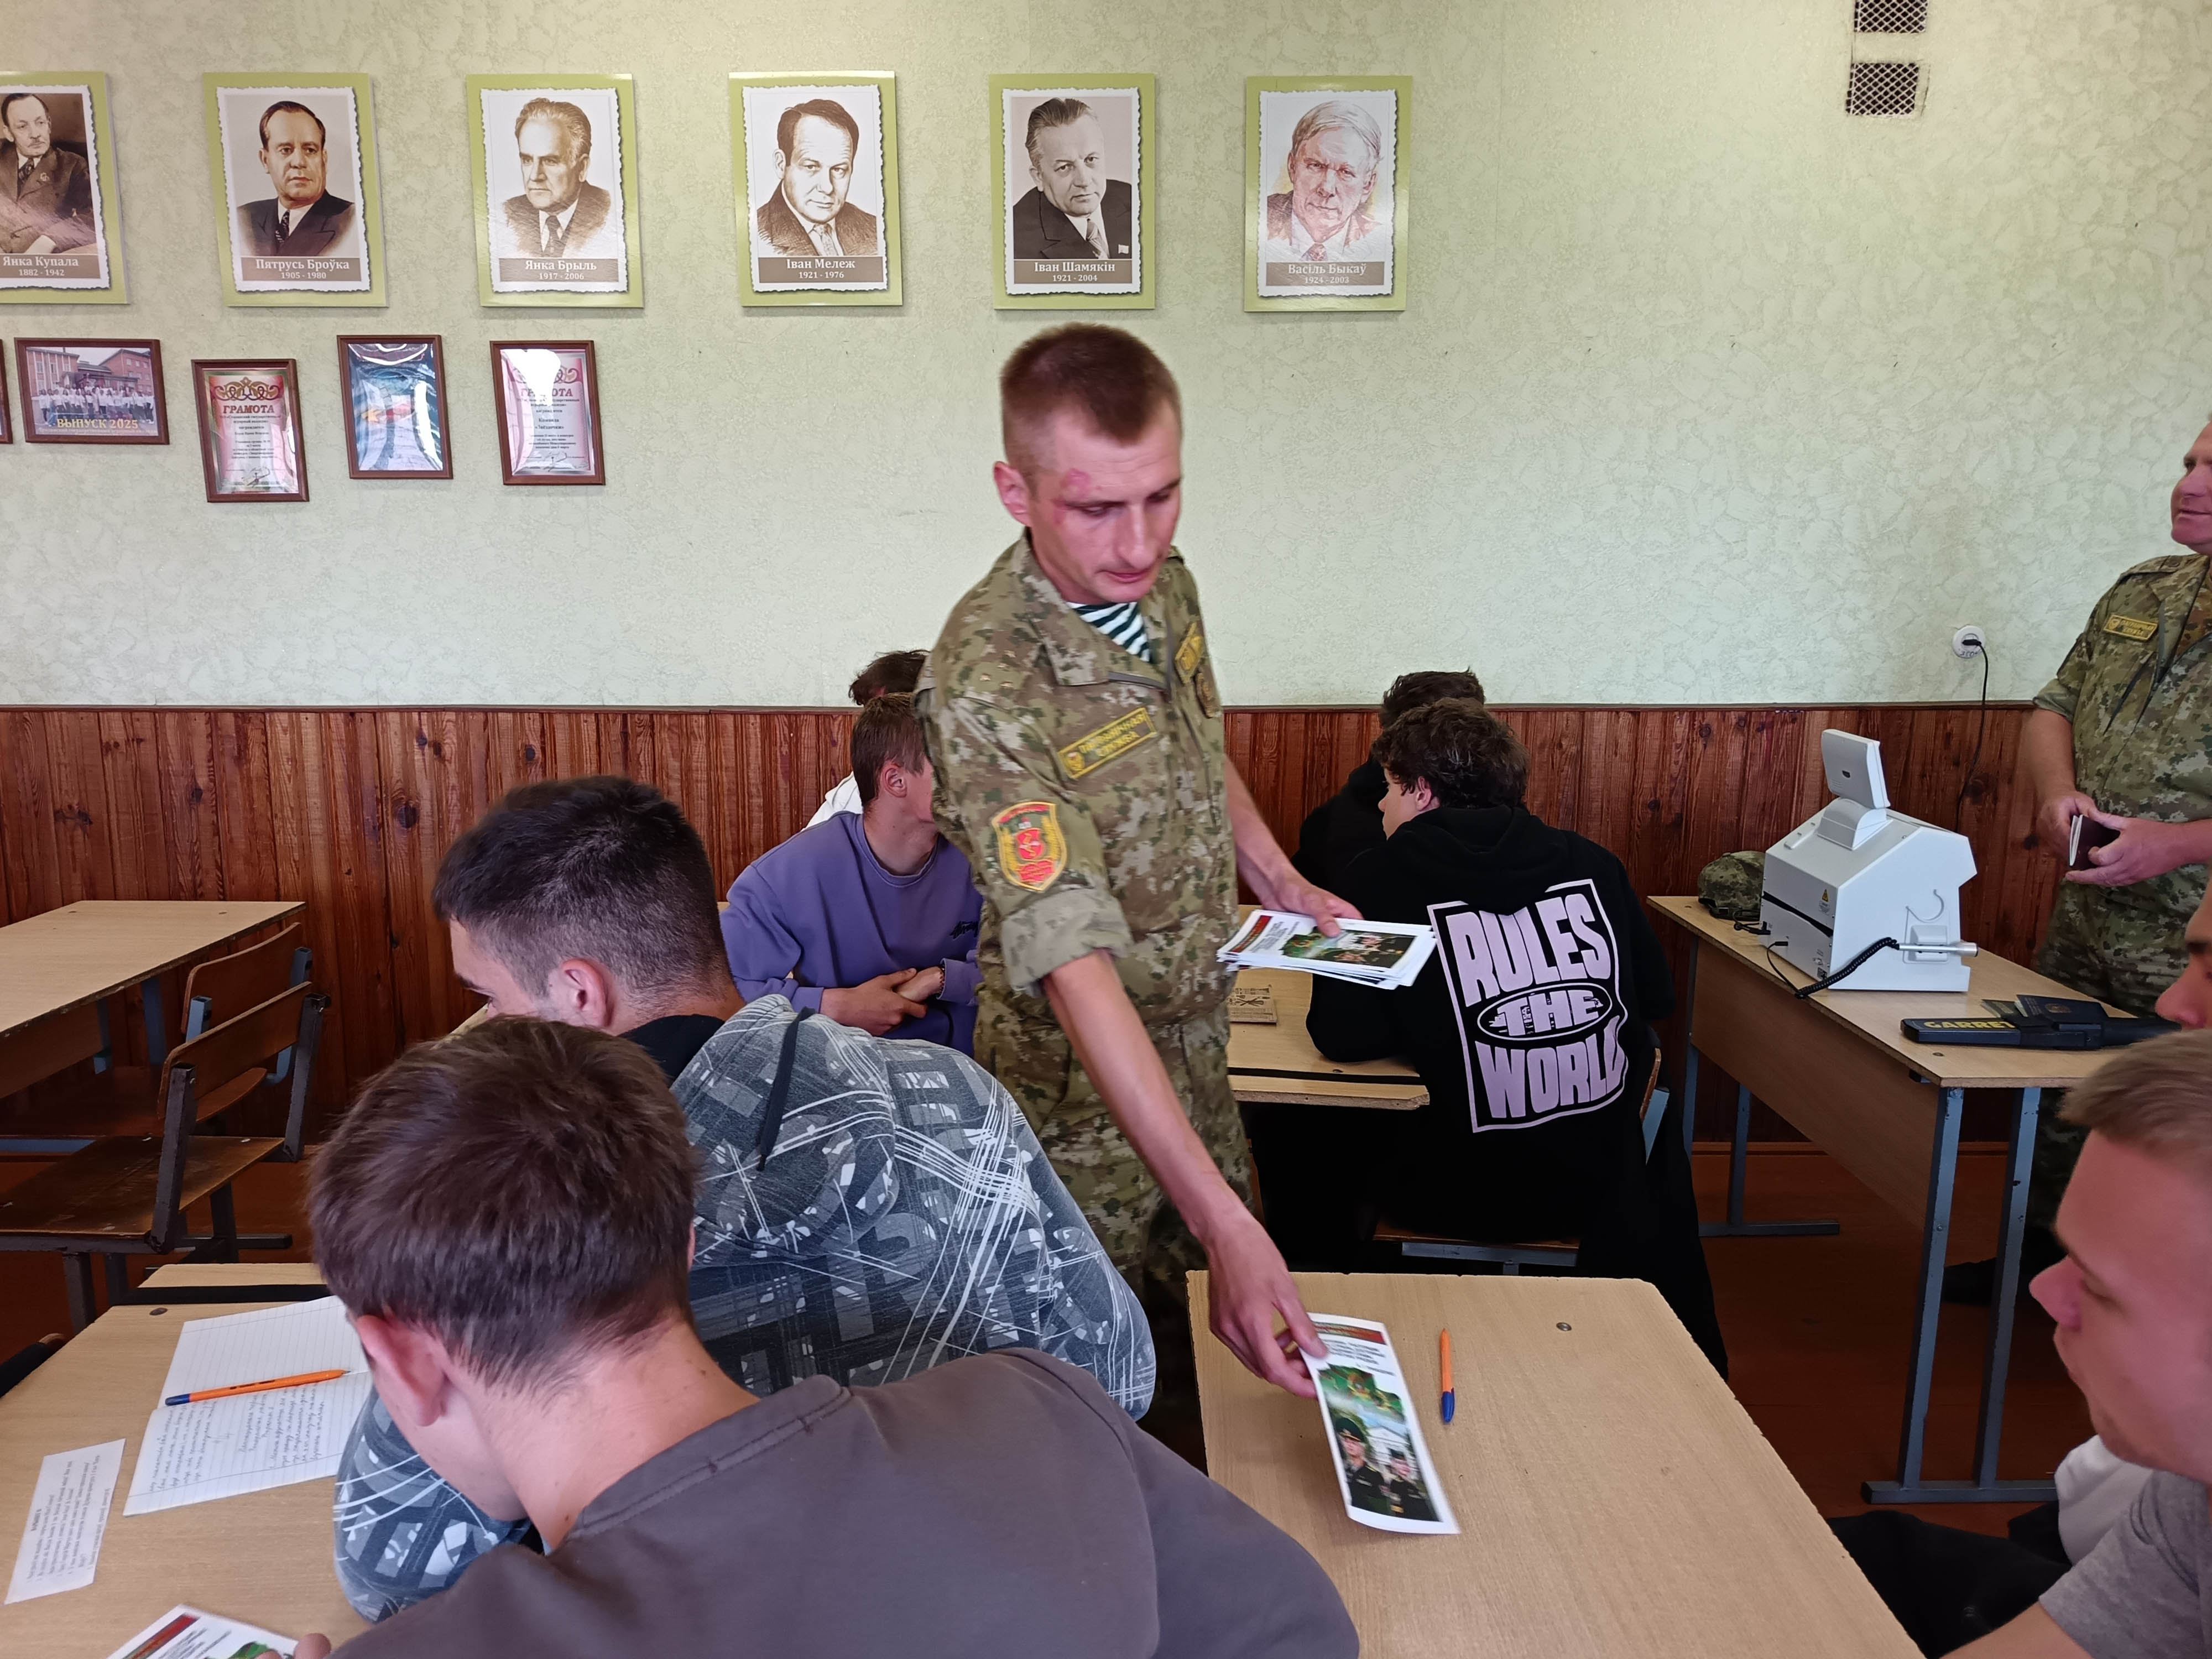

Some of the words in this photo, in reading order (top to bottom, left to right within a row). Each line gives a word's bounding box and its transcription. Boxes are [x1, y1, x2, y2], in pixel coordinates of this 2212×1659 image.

[3, 256, 33, 266] Янка
[35, 256, 79, 268] Купала
[255, 259, 304, 271] Пятрусь
[307, 259, 349, 272] Броўка
[525, 260, 555, 270] Янка
[557, 260, 597, 272] Брыль
[786, 259, 812, 269] Іван
[815, 258, 855, 269] Мележ
[1035, 262, 1060, 272] Іван
[1062, 262, 1115, 272] Шамякін
[1288, 264, 1326, 274] Васіль
[1328, 263, 1366, 275] Быкаў
[223, 405, 275, 414] ГРАМОТА
[56, 419, 107, 429] ВЫПУСК
[110, 419, 138, 429] 2025
[1446, 893, 1611, 1007] RULES
[1496, 990, 1601, 1036] THE
